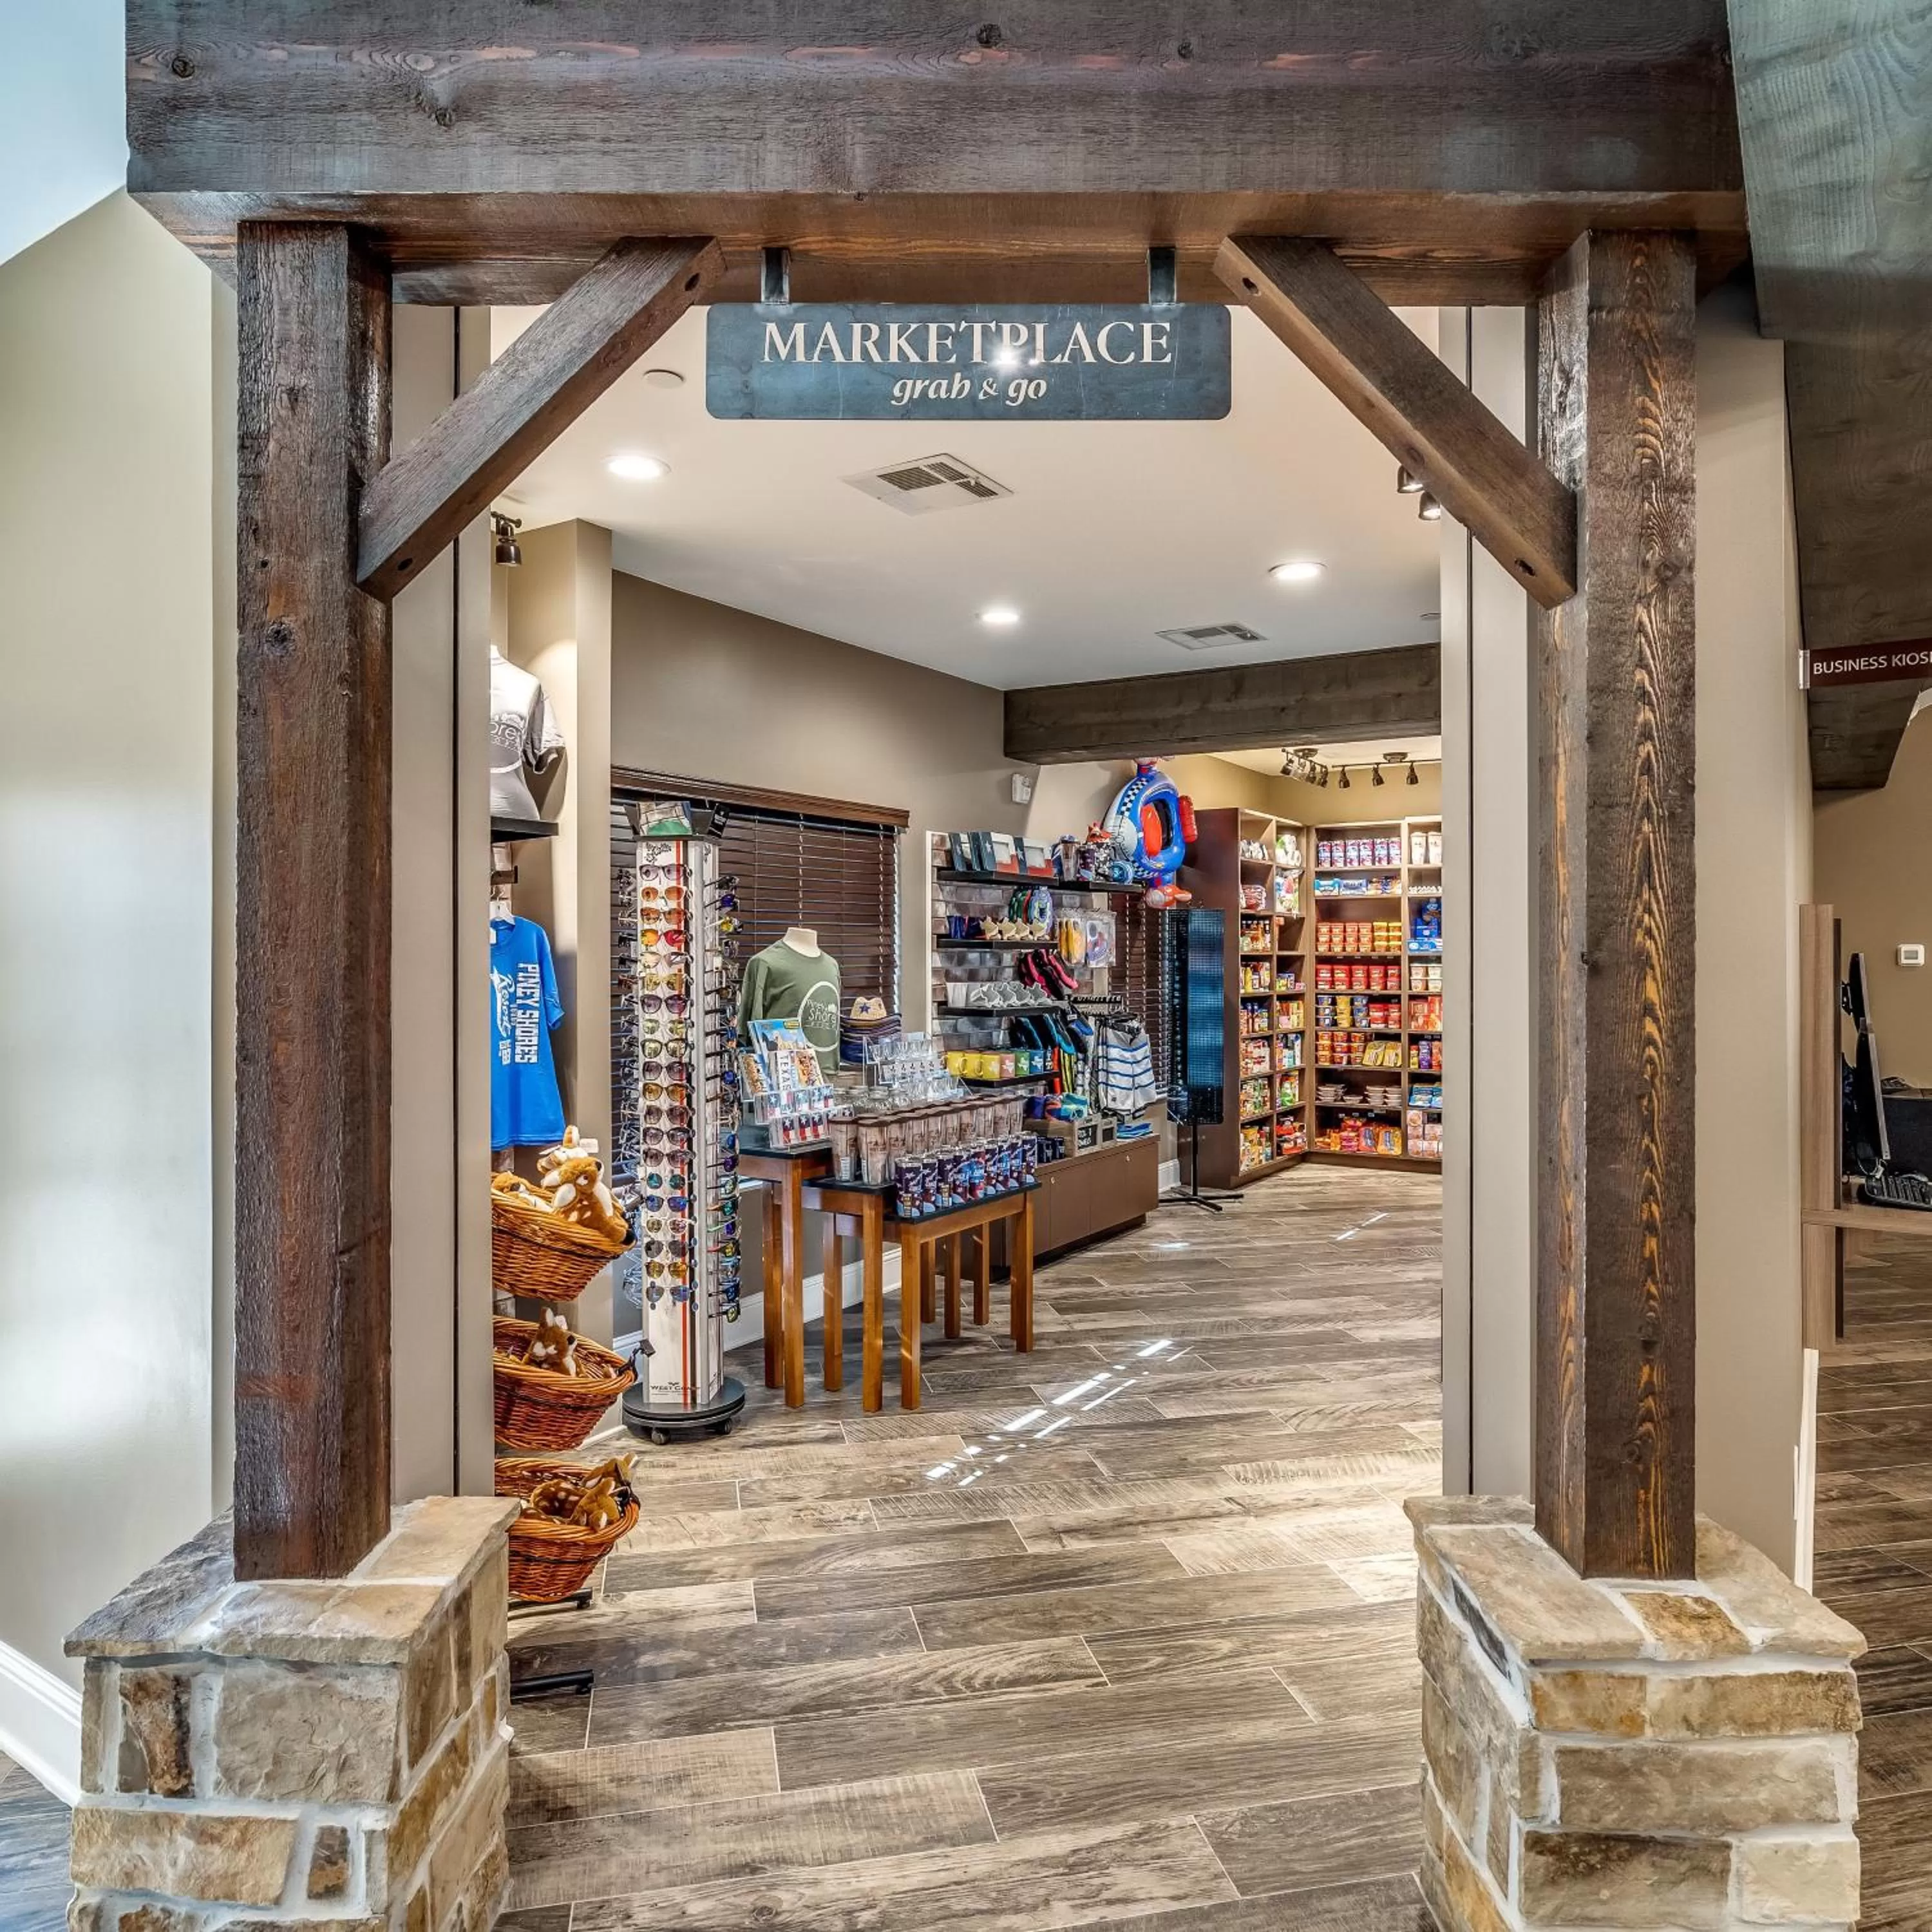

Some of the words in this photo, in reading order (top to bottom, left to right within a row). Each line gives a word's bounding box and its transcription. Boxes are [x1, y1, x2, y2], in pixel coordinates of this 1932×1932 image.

[761, 320, 1172, 365] MARKETPLACE
[891, 372, 971, 406] grab
[978, 377, 999, 401] &
[1005, 376, 1048, 406] go
[1813, 656, 1888, 675] BUSINESS
[1891, 651, 1932, 668] KIOS
[516, 963, 540, 1007] PINEY
[515, 1010, 539, 1063] SHORES
